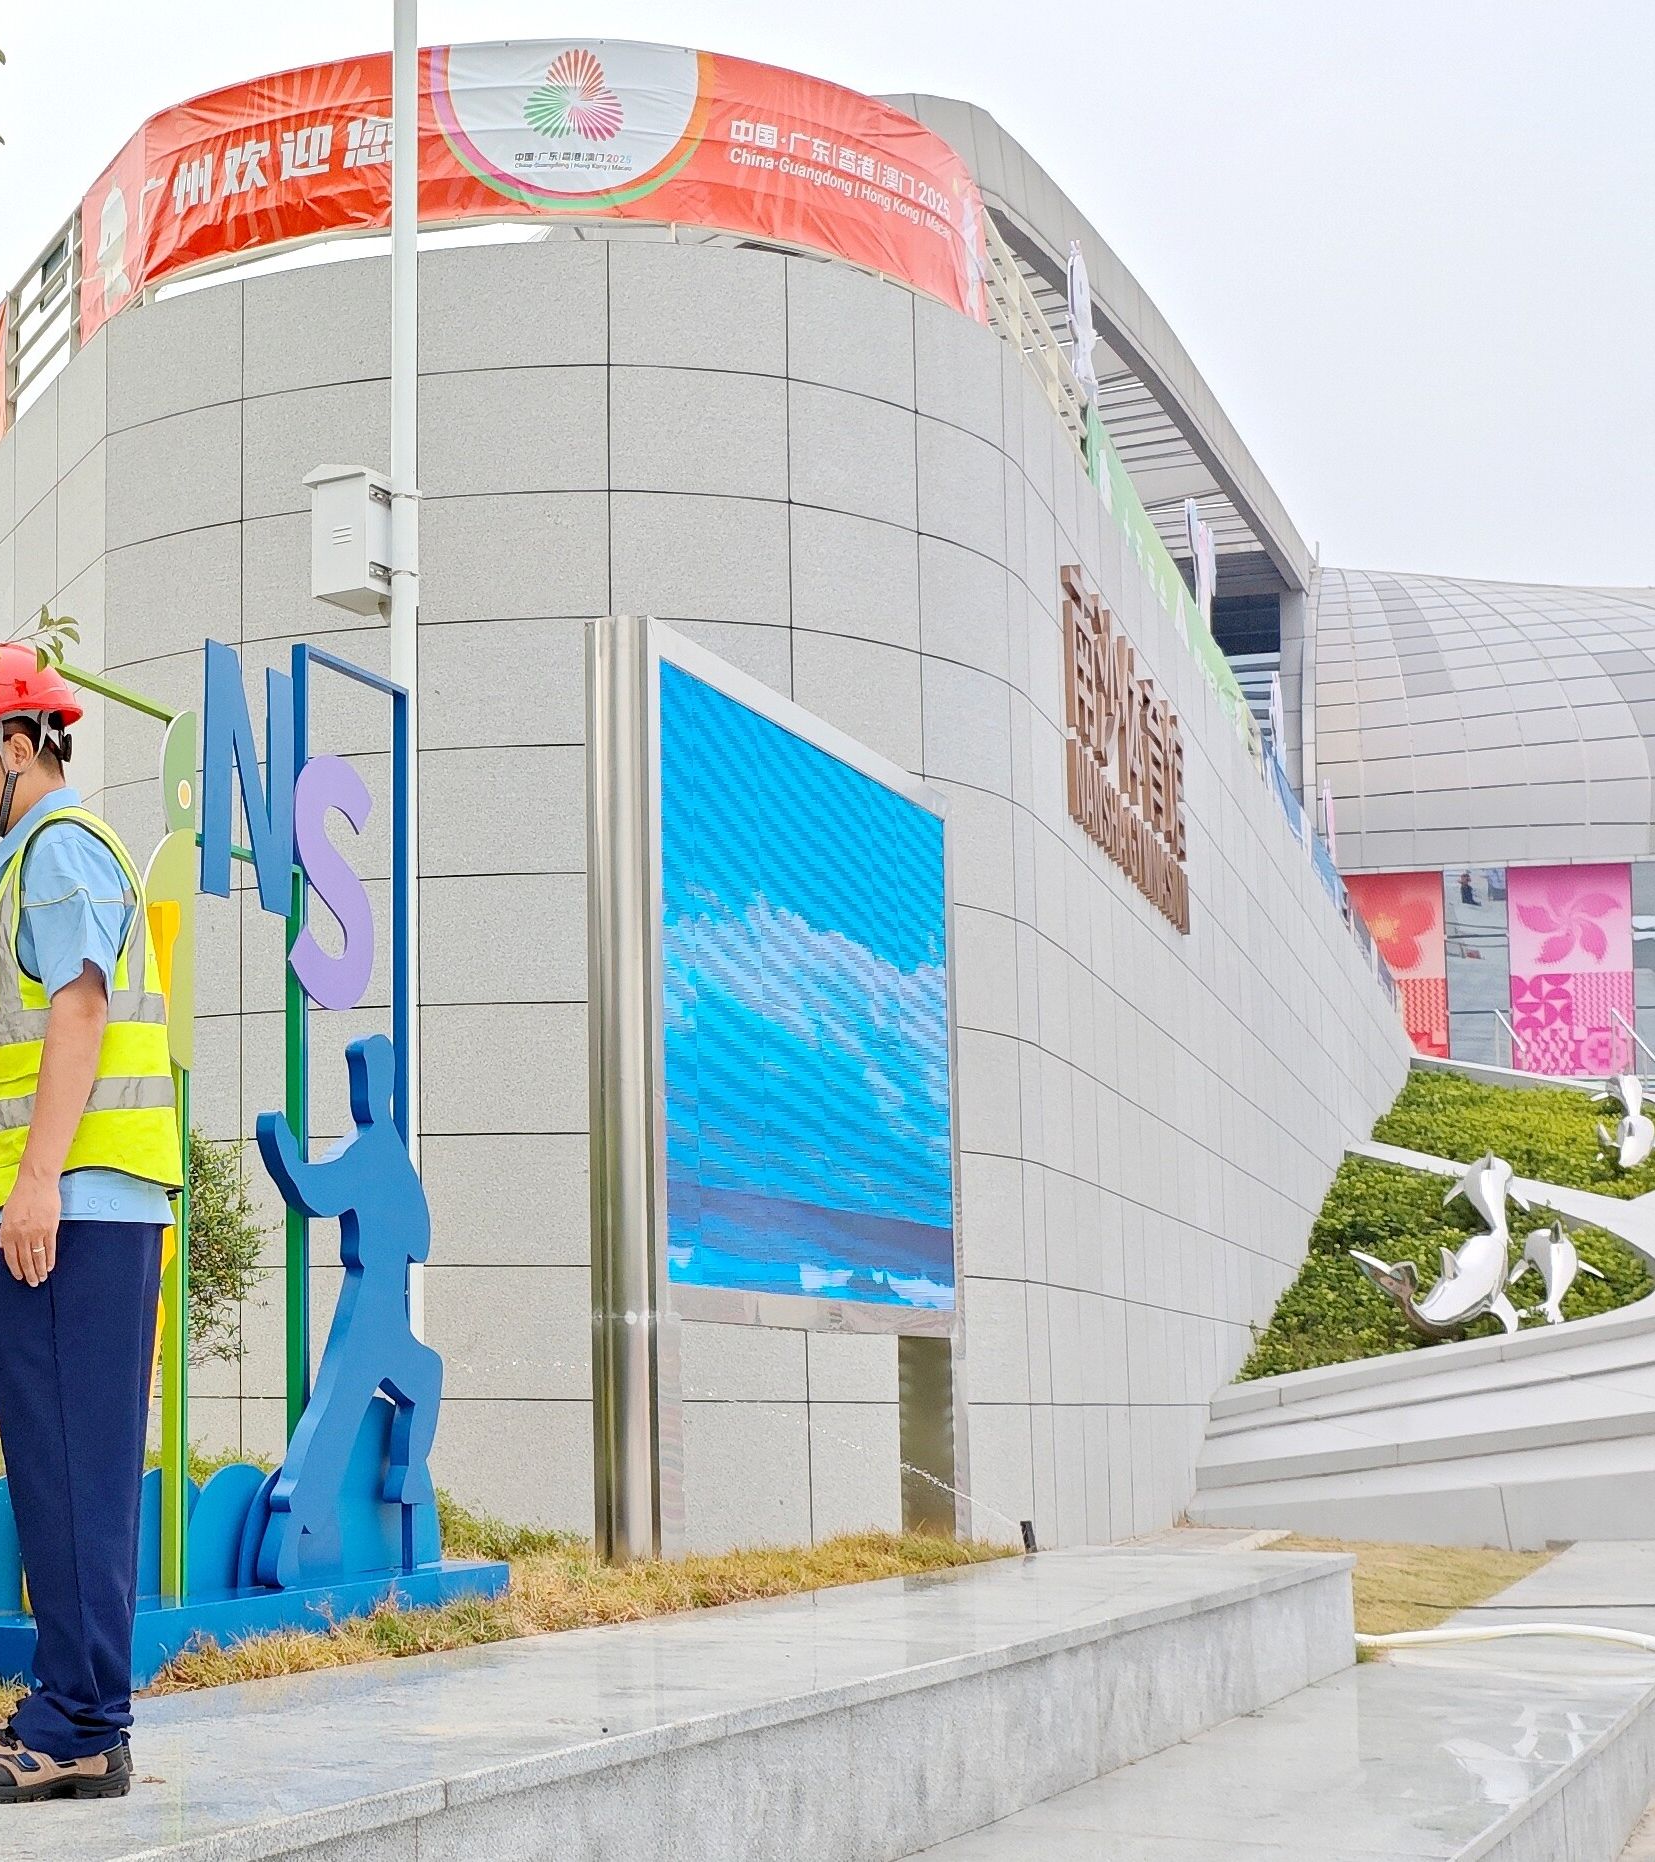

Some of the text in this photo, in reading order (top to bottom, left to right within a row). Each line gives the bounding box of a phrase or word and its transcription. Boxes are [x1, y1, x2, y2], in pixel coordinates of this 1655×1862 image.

[138, 116, 392, 234] 广州欢迎您
[860, 186, 891, 212] Hong
[892, 198, 920, 225] Kong
[1060, 564, 1187, 862] 南沙体育馆
